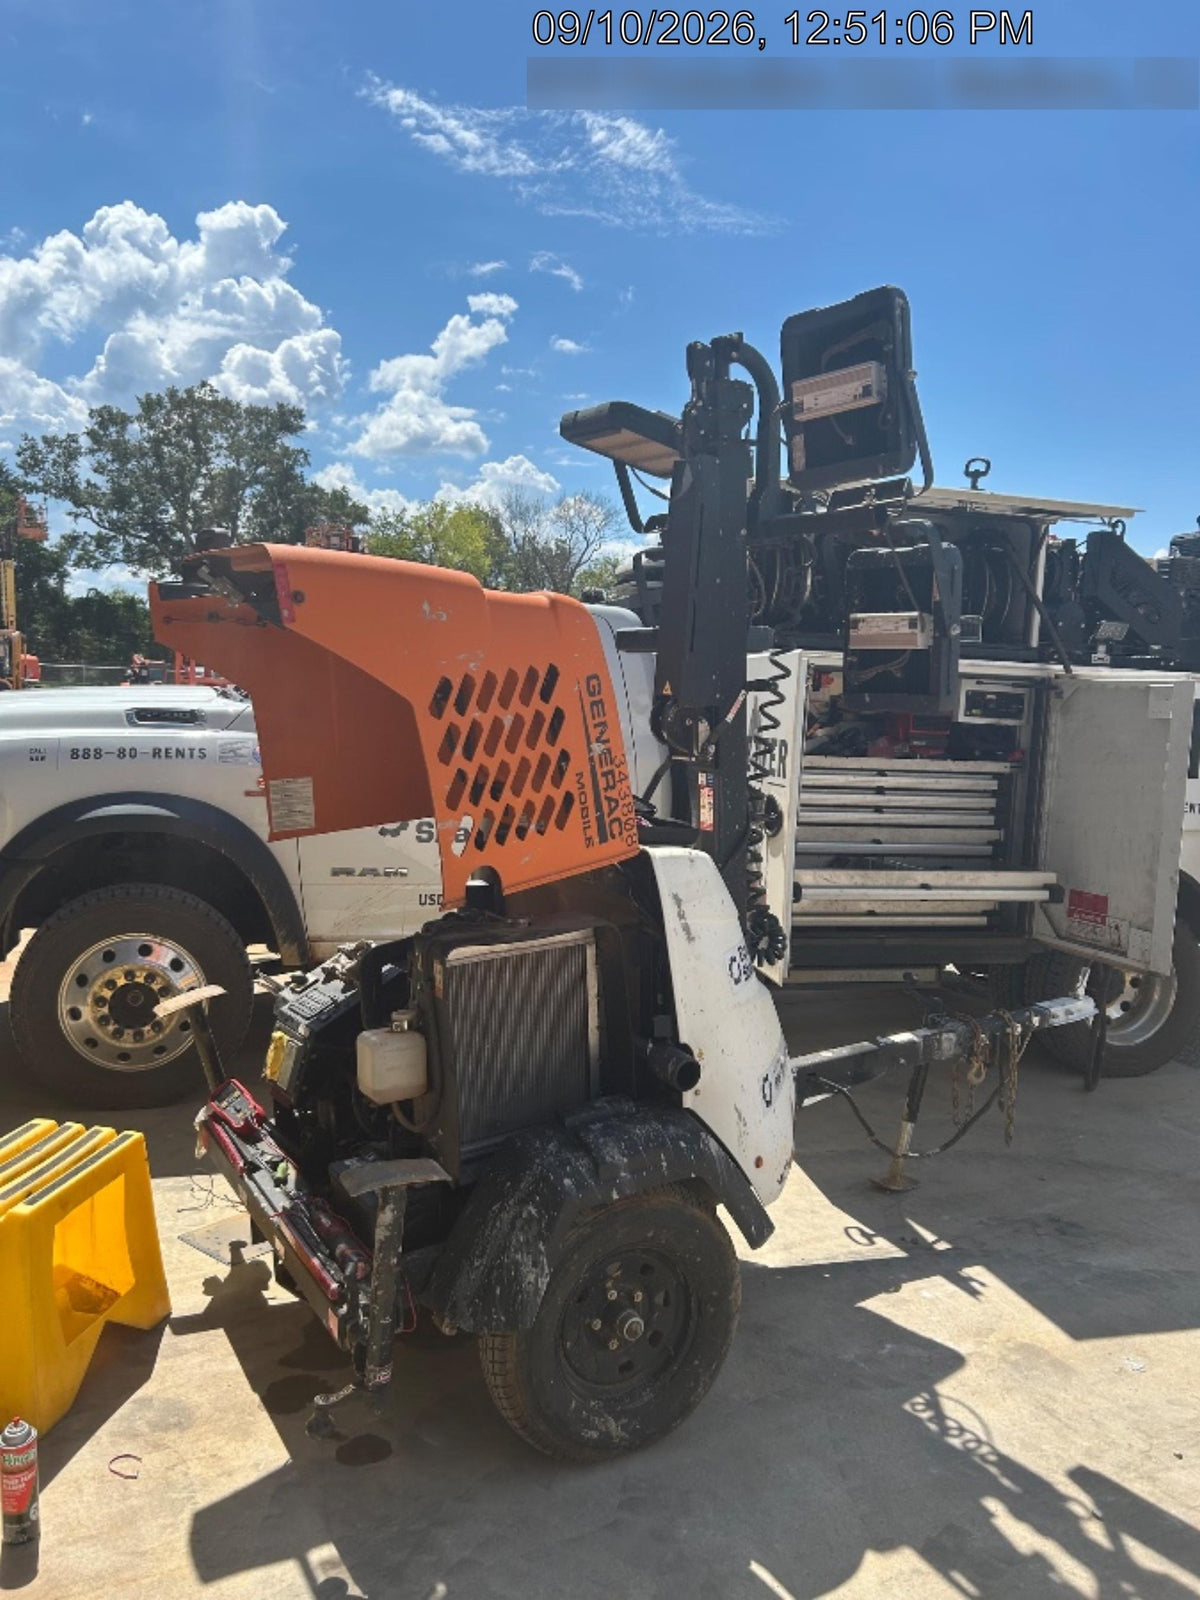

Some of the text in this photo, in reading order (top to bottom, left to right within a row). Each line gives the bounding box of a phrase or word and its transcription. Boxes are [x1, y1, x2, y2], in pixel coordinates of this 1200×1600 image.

[70, 747, 207, 760] 888-80-RENTS
[585, 673, 624, 840] GENERAC
[576, 771, 595, 848] MOBILE
